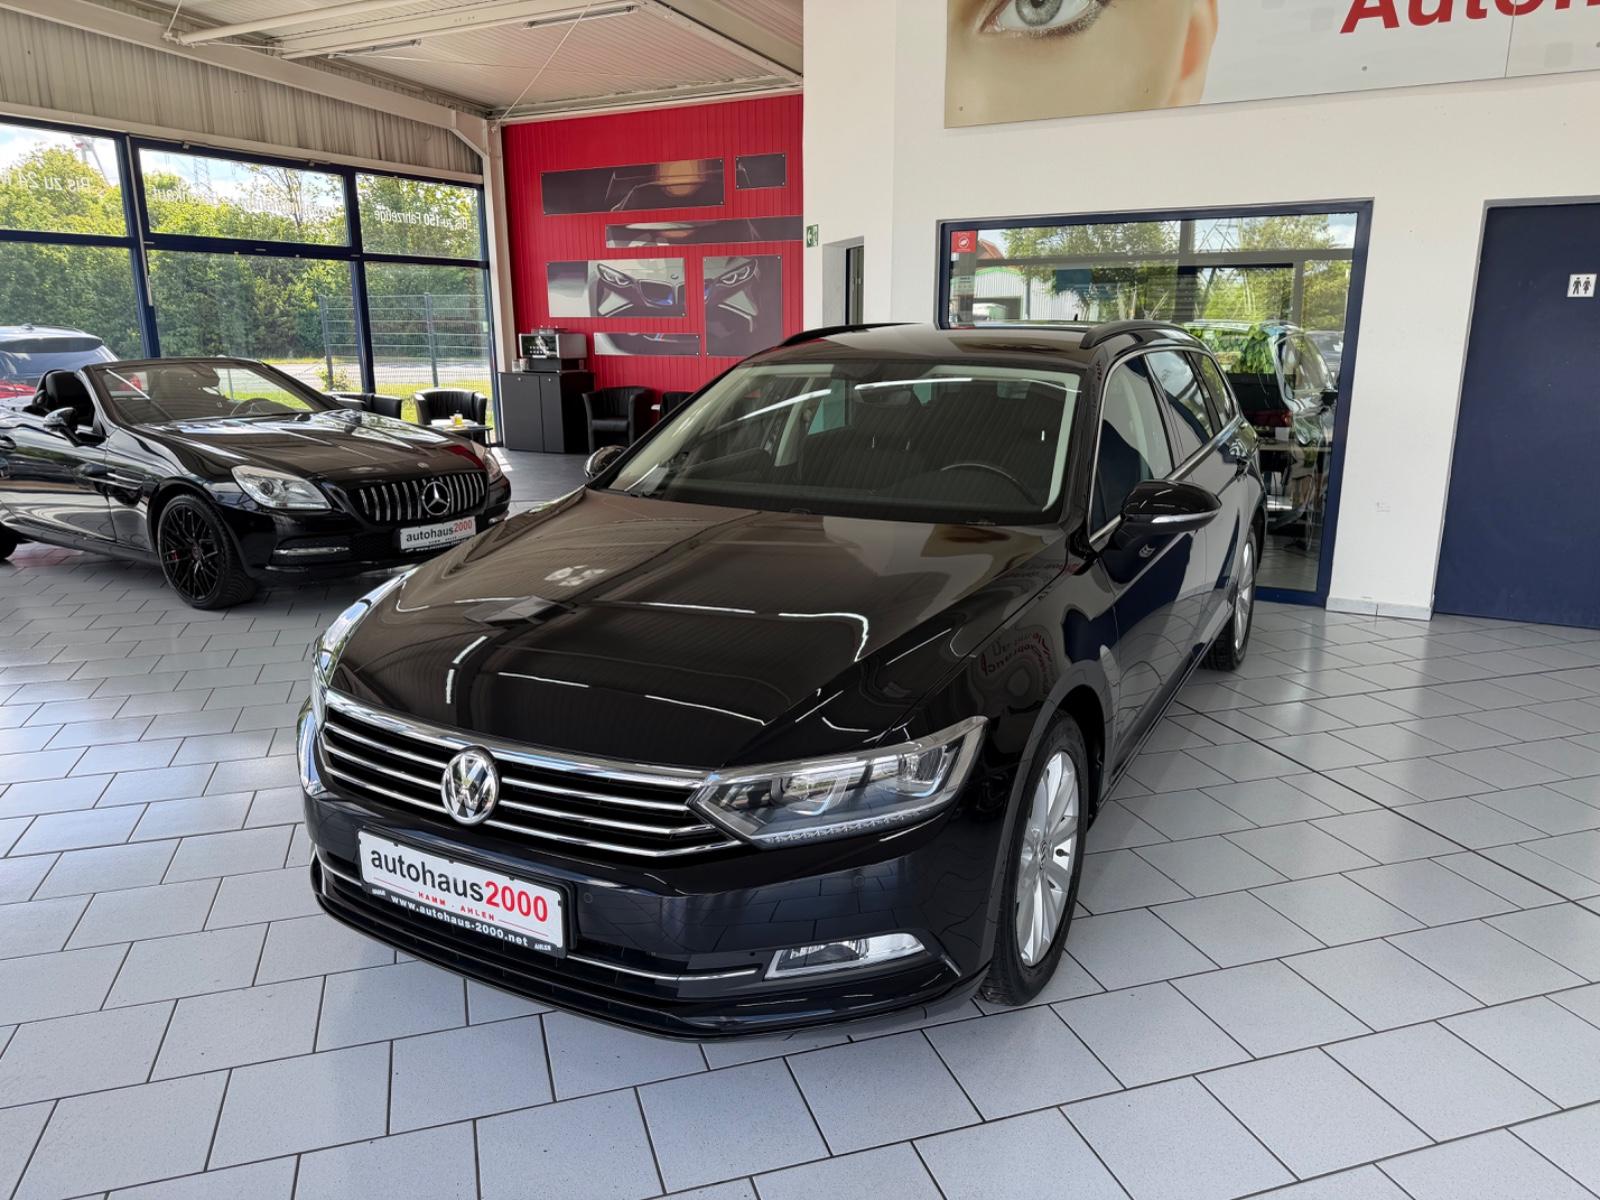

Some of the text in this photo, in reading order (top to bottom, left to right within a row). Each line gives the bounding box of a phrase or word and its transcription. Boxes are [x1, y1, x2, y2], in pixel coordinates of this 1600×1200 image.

[406, 519, 473, 542] autohaus2000
[371, 850, 548, 922] autohaus2000
[418, 891, 495, 921] HAMM AHLEN
